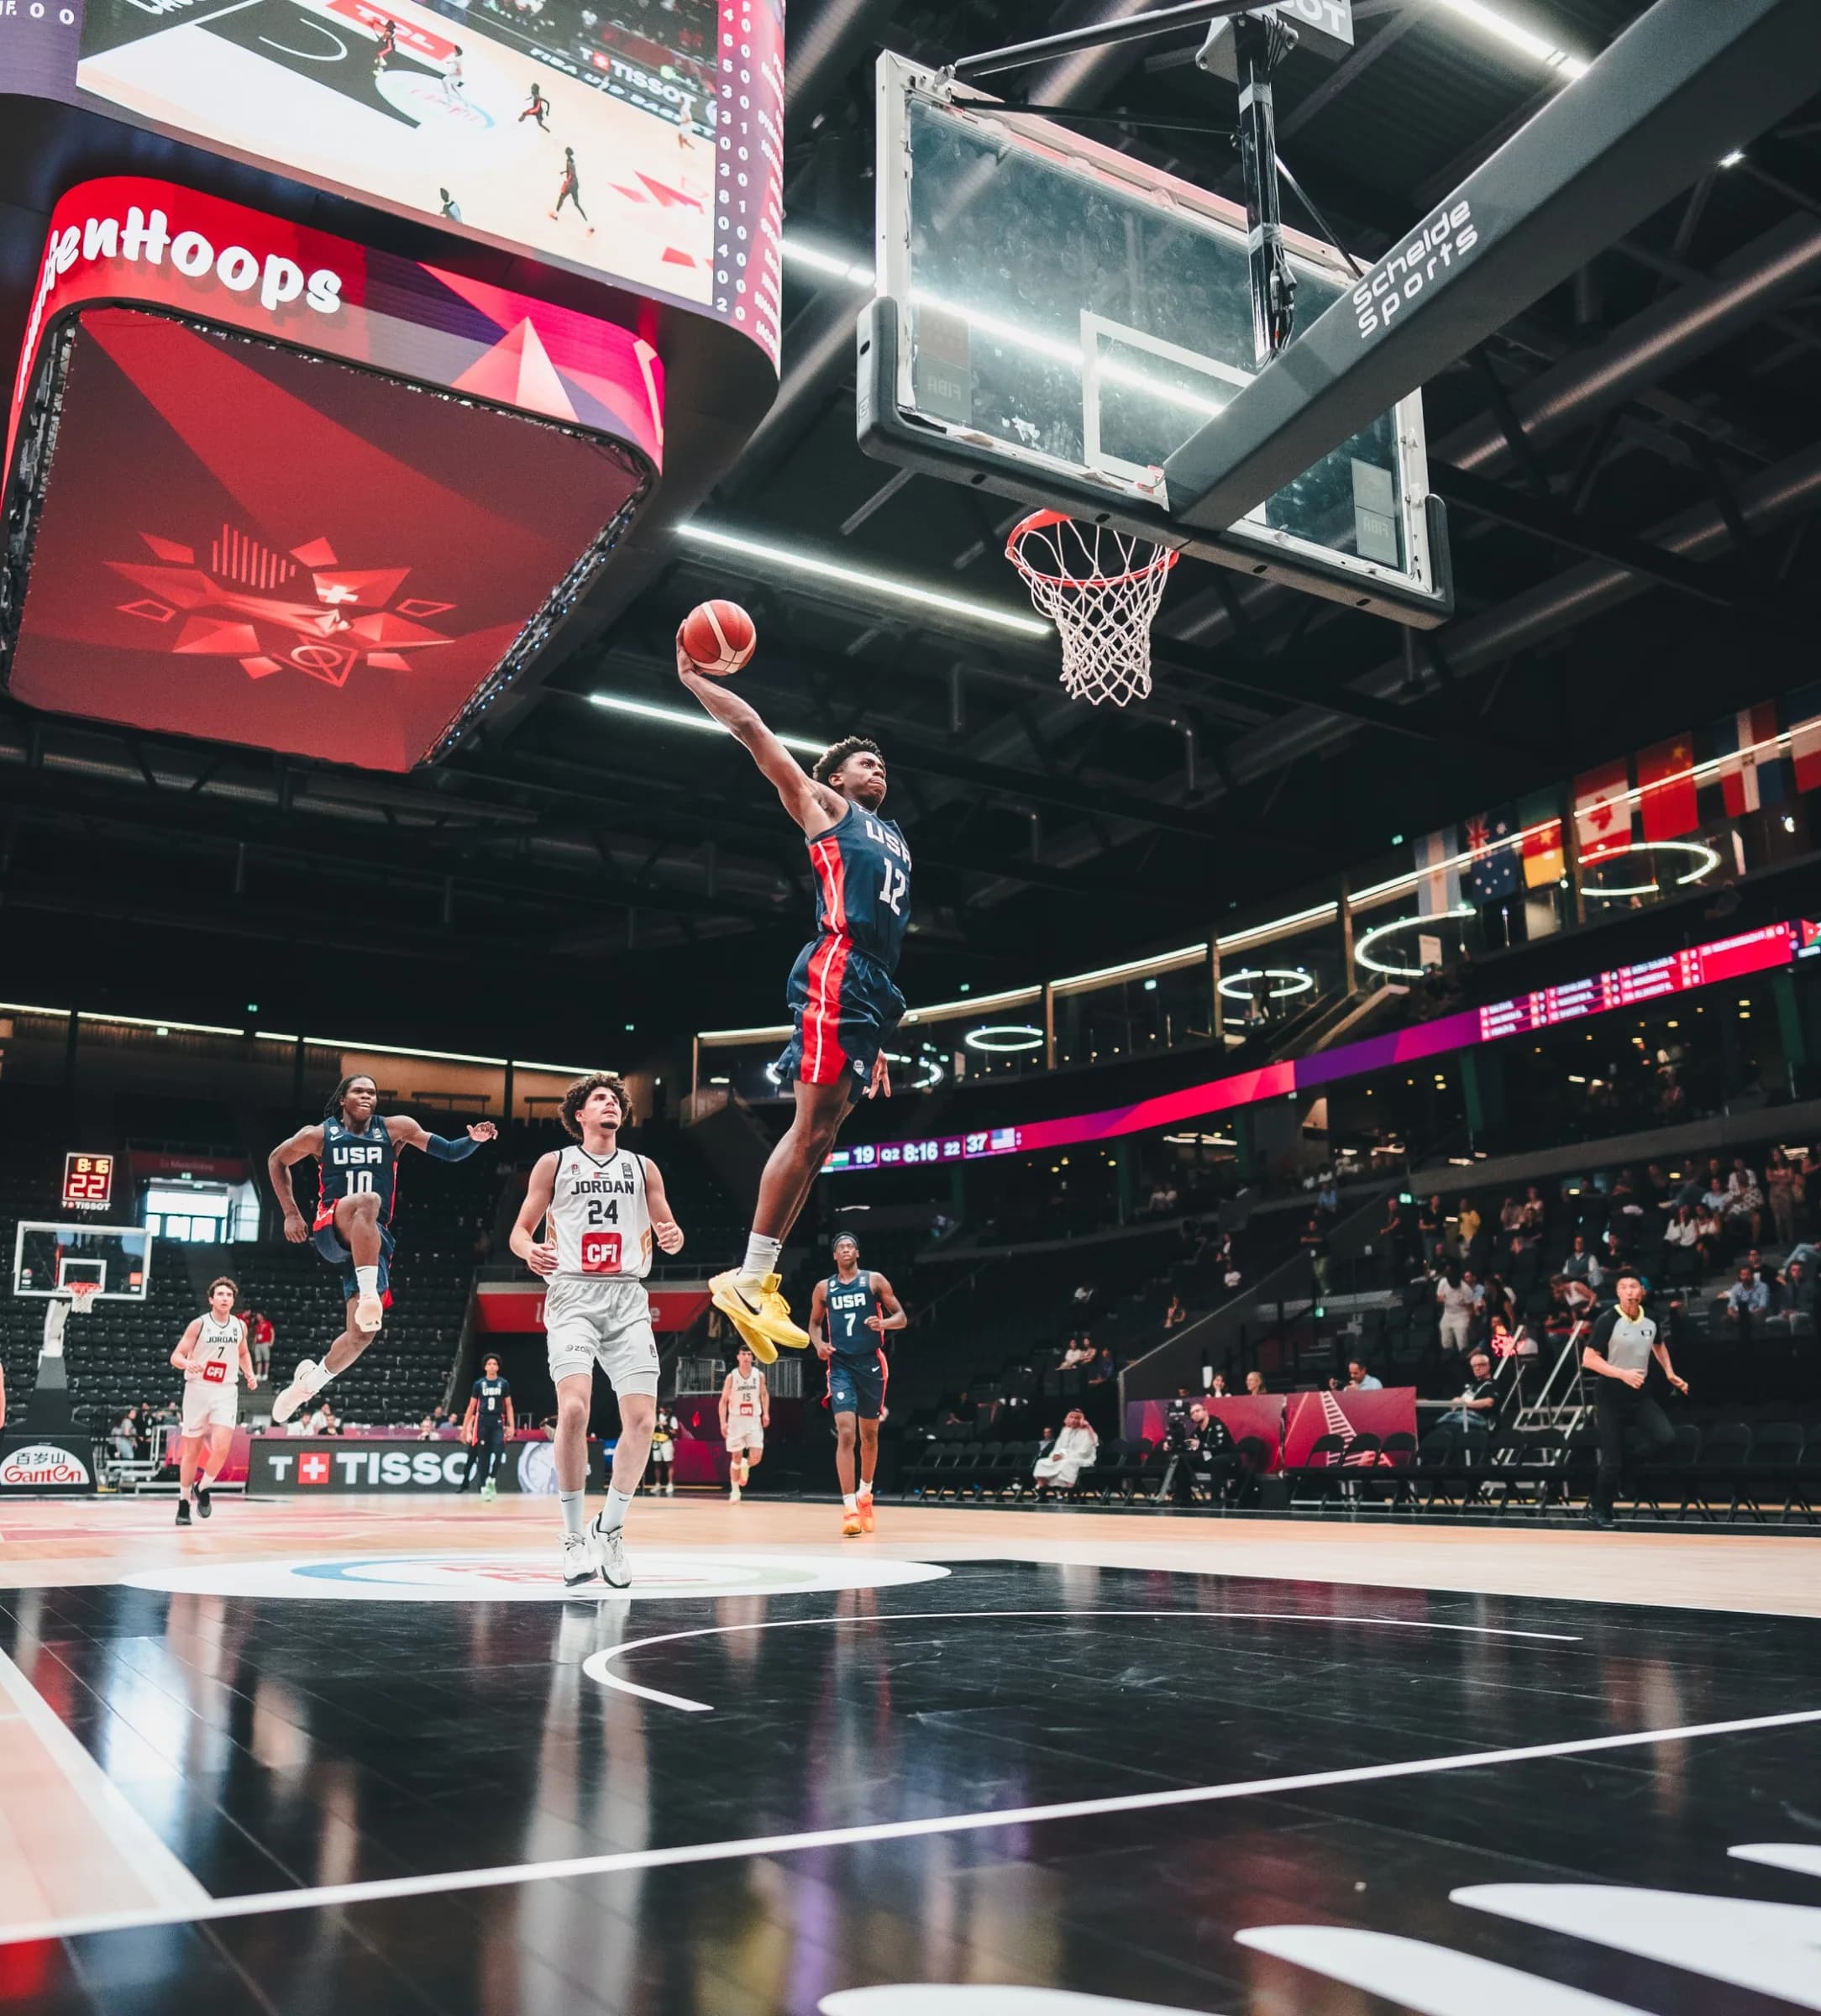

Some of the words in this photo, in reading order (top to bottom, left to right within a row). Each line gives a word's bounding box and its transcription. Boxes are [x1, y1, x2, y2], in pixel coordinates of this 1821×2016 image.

[716, 297, 727, 312] 2
[865, 820, 912, 873] USA
[879, 857, 906, 916] 12
[333, 1147, 383, 1165] USA
[853, 1145, 875, 1164] 19
[880, 1147, 900, 1162] Q2
[902, 1141, 939, 1163] 8:16
[943, 1141, 961, 1158] 22
[966, 1132, 989, 1153] 37
[69, 1173, 106, 1199] 22
[345, 1170, 373, 1197] 10
[570, 1179, 635, 1195] JORDAN
[588, 1199, 619, 1226] 24
[587, 1243, 618, 1263] CFI
[831, 1293, 867, 1310] USA
[844, 1312, 857, 1337] 7
[207, 1336, 238, 1344] JORDAN
[218, 1347, 225, 1359] 7
[17, 1452, 66, 1465] 百岁山
[336, 1452, 506, 1484] TISSO
